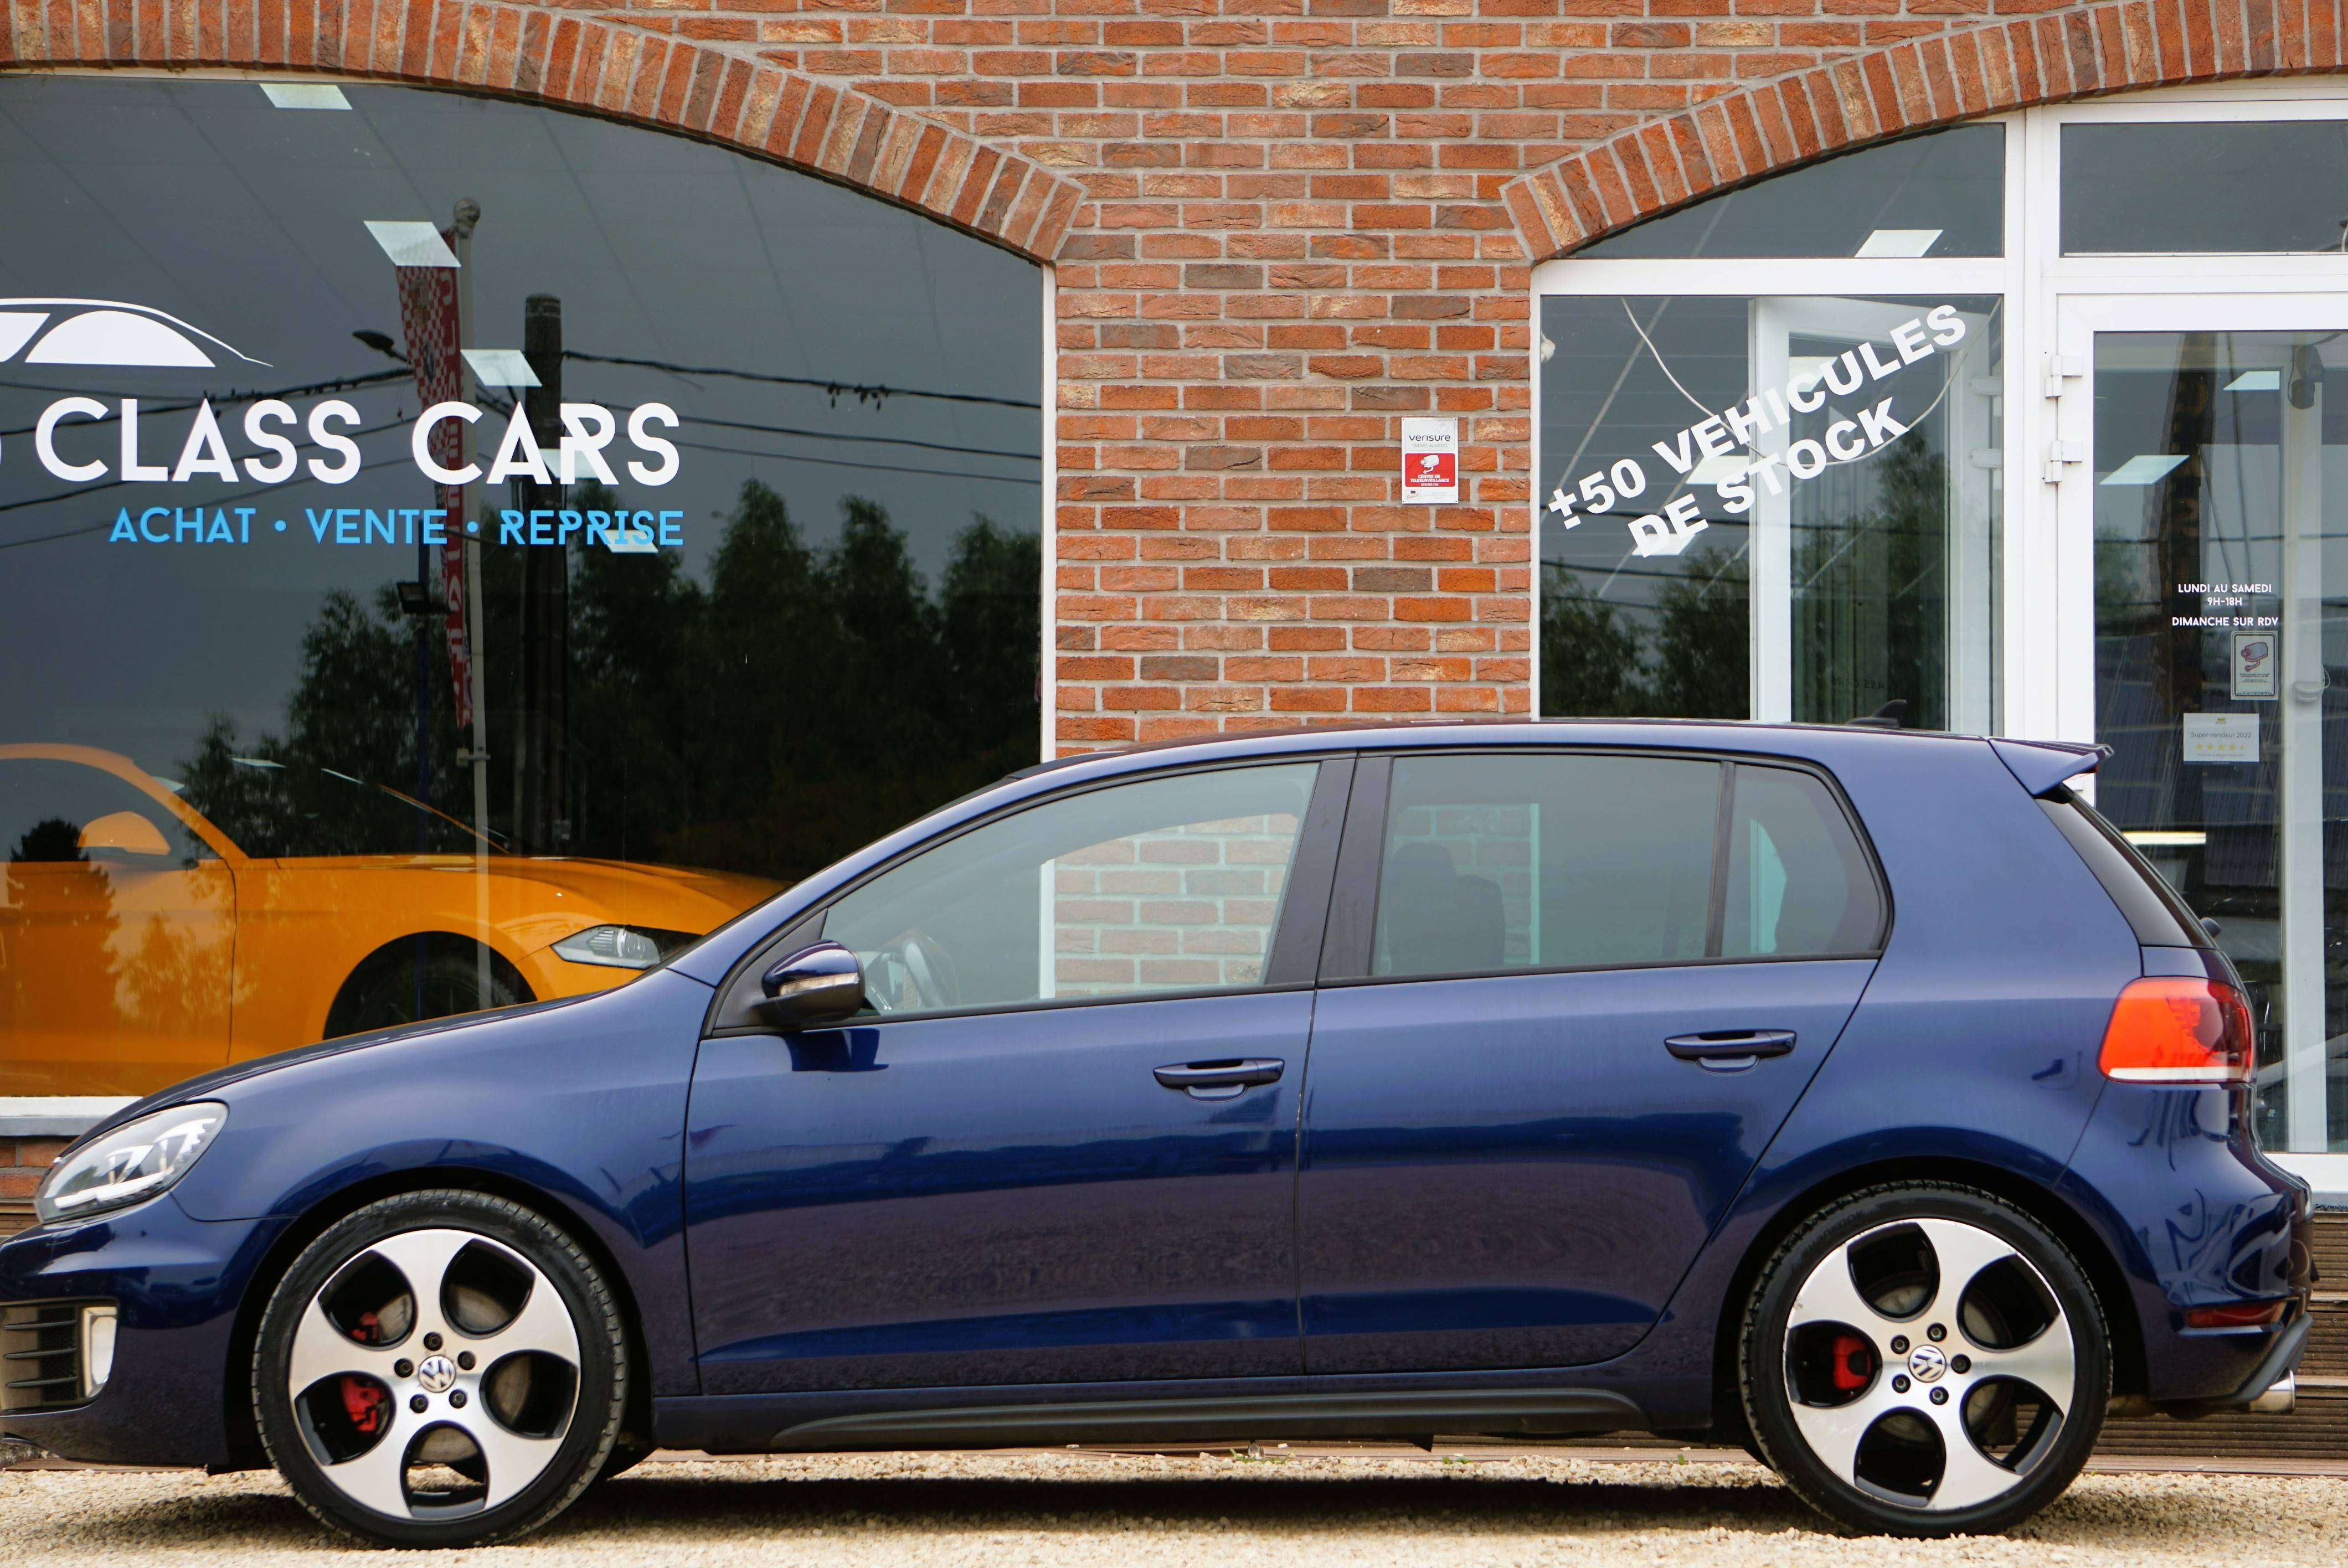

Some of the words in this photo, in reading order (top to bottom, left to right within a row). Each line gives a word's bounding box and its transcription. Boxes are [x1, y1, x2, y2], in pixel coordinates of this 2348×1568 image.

[1651, 305, 1966, 475] VEHICULES
[35, 397, 361, 484] CLASS
[412, 401, 680, 486] CARS
[1627, 493, 1709, 558] DE
[1716, 397, 1909, 514] STOCK
[109, 507, 256, 543] ACHAT
[305, 508, 447, 545] VENTE
[501, 509, 684, 546] REPRISE
[2178, 584, 2210, 593] LUNDI
[2214, 584, 2228, 593] AU
[2232, 584, 2272, 593] SAMEDI
[2207, 597, 2242, 606] 9H-18H
[2172, 617, 2229, 626] DIMANCHE
[2233, 617, 2254, 626] SUR
[2258, 617, 2279, 626] RDV
